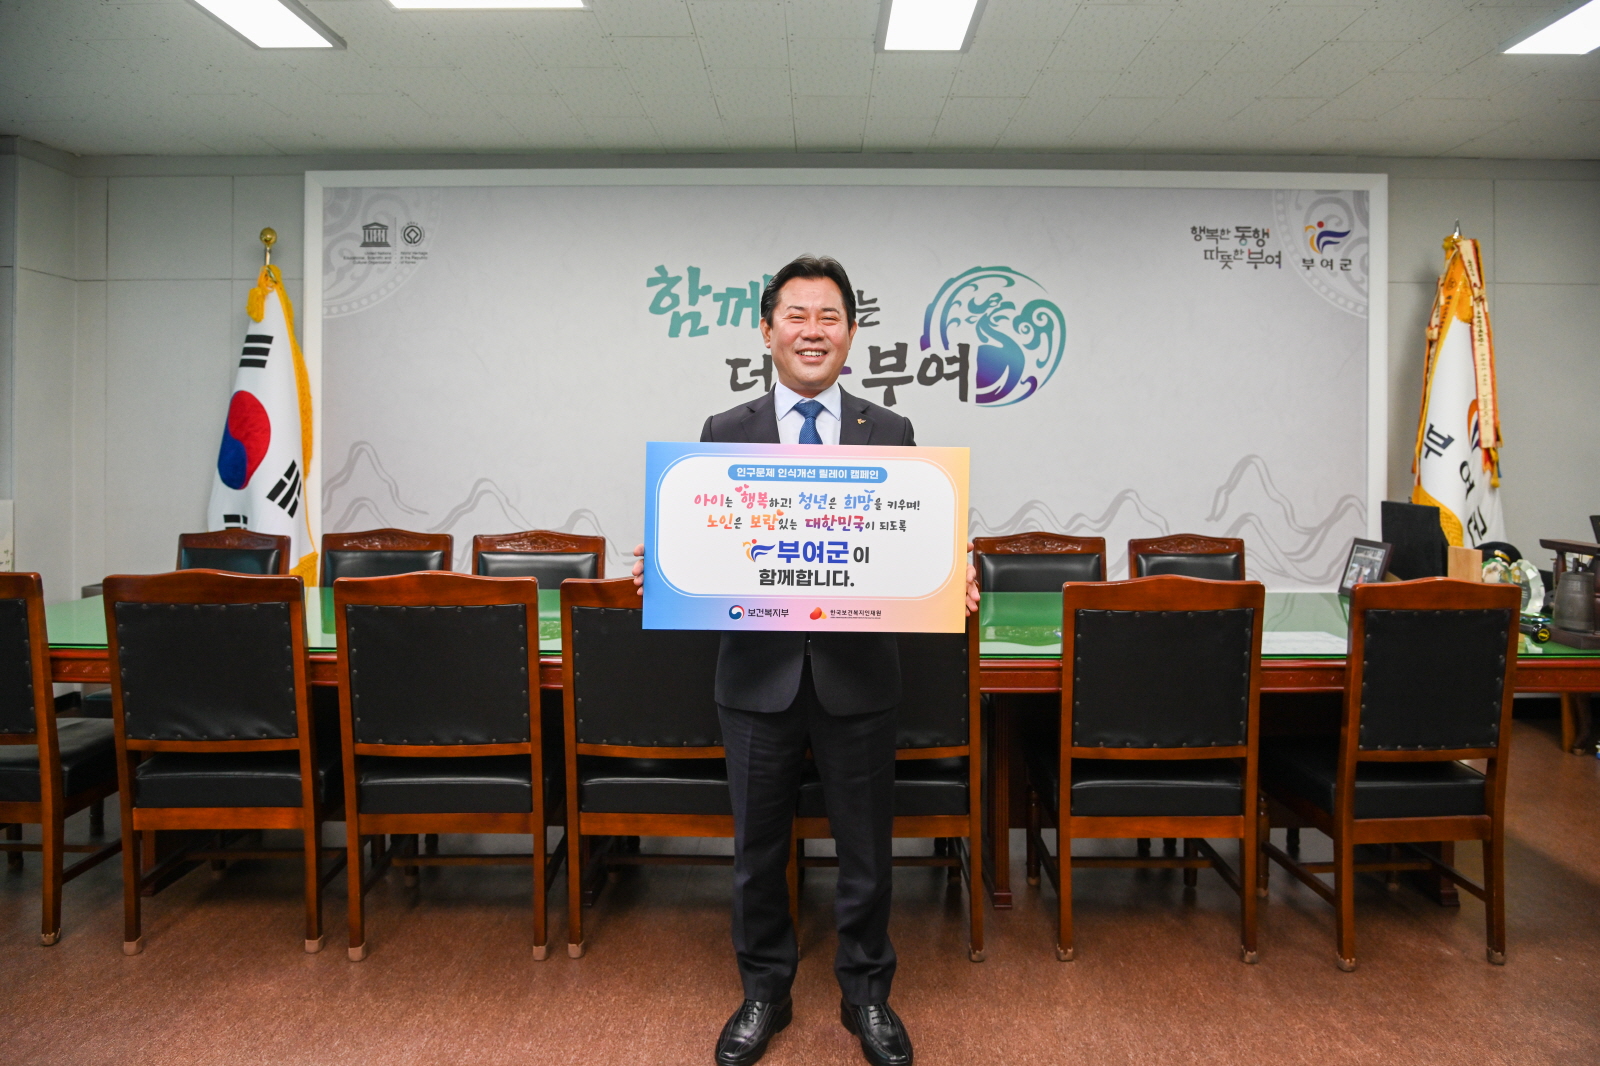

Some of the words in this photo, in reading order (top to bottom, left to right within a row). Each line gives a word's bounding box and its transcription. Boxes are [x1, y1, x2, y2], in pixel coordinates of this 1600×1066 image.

[1190, 225, 1231, 245] 행복한
[1234, 225, 1270, 248] 동행
[1203, 246, 1245, 270] 따뜻한
[1246, 248, 1282, 270] 부여
[1301, 258, 1353, 271] 부여군
[861, 341, 970, 407] 부여
[736, 467, 775, 478] 인구문제
[777, 468, 816, 479] 인식개선
[818, 468, 847, 479] 릴레이
[850, 469, 879, 480] 캠페인
[694, 493, 733, 508] 아이는
[740, 490, 792, 510] 행복하고!
[798, 491, 837, 510] 청년은
[843, 493, 882, 511] 희망을
[887, 498, 921, 511] 키우며!
[706, 513, 743, 530] 노인은
[750, 513, 798, 531] 보람있는
[804, 514, 875, 532] 대한민국이
[879, 519, 907, 532] 되도록
[758, 568, 855, 587] 함께합니다.
[747, 608, 790, 618] 보건복지부
[829, 609, 882, 617] 한국보건복지인재원
